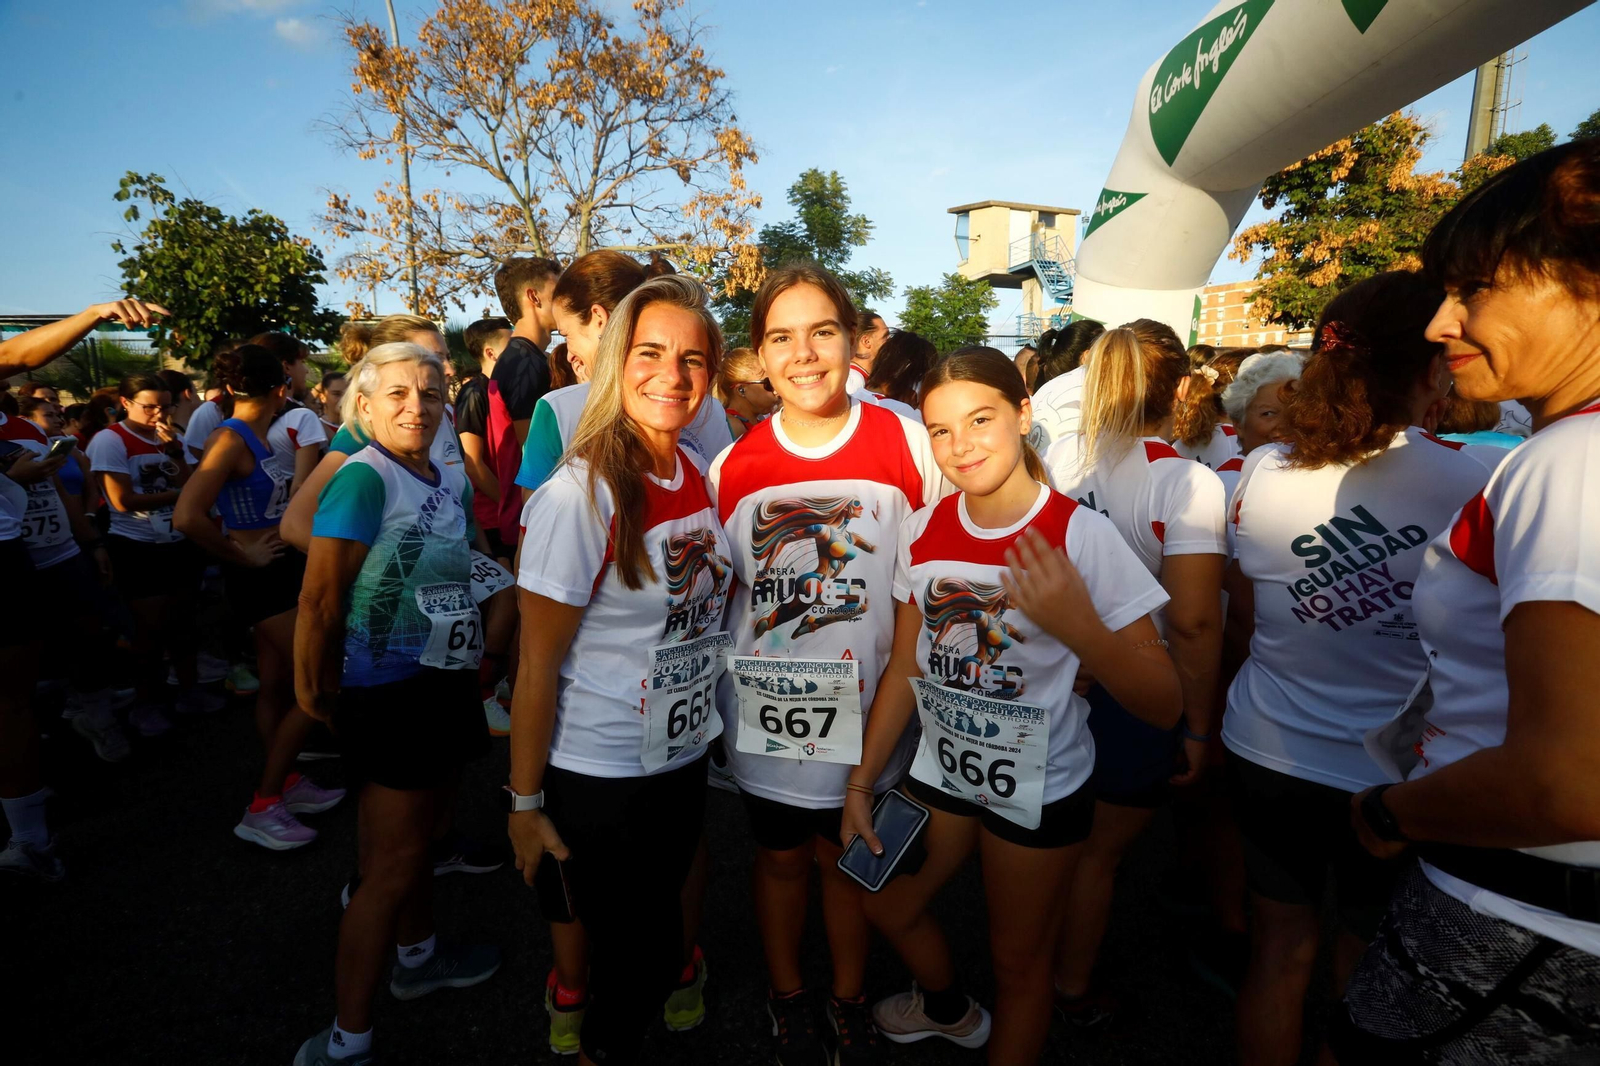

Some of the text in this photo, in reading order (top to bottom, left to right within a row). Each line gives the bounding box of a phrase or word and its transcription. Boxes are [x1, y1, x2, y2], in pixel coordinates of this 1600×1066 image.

[1150, 7, 1248, 114] El Corte Inglés
[1291, 504, 1389, 568] SIN
[1287, 525, 1428, 602] IGUALDAD
[422, 593, 463, 607] 2024
[752, 577, 867, 608] MUJER
[1290, 562, 1395, 624] NO HAY
[1318, 581, 1414, 632] TRATO
[448, 620, 482, 651] 62
[655, 644, 692, 656] CIRCUITO
[654, 659, 691, 676] 2024
[734, 659, 777, 668] CIRCUITO
[779, 661, 836, 669] PROVINCIAL
[734, 664, 854, 675] CARRERAS POPULARES
[667, 682, 712, 739] 665
[960, 694, 1023, 712] PROVINCIAL
[971, 703, 1045, 720] POPULARES
[759, 704, 837, 738] 667
[965, 736, 978, 746] MUJER
[985, 742, 1008, 752] CÓRDOBA
[1008, 746, 1021, 754] 2024
[937, 736, 1017, 798] 666
